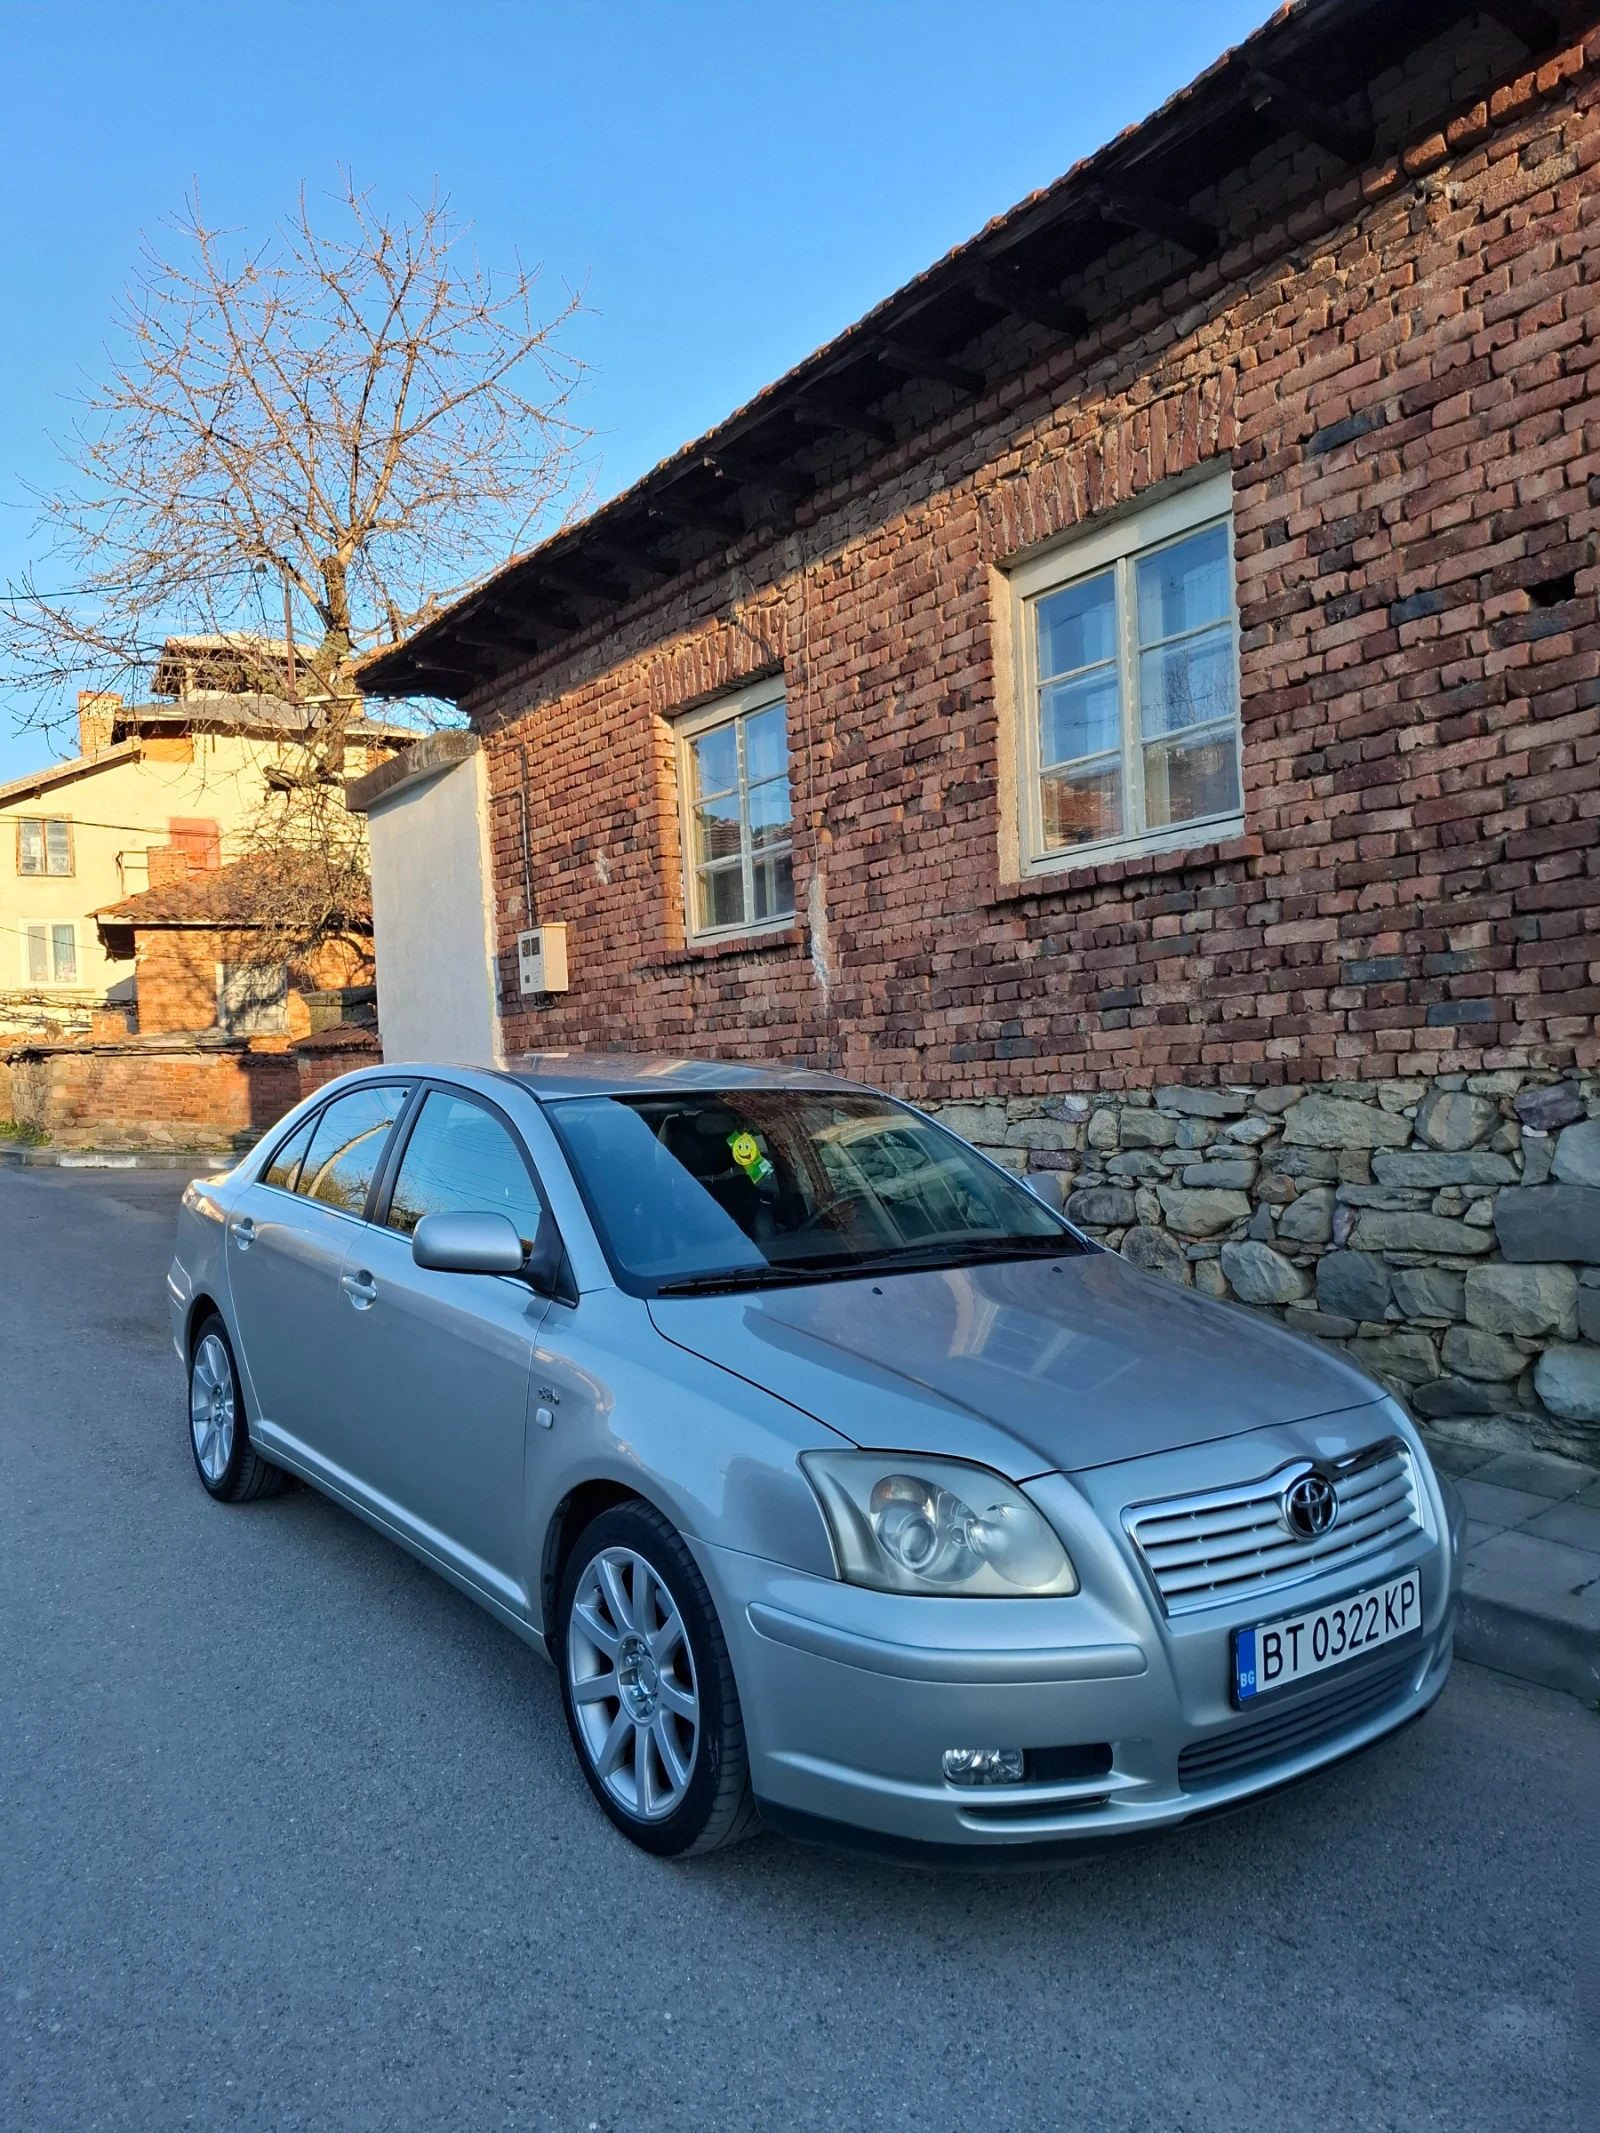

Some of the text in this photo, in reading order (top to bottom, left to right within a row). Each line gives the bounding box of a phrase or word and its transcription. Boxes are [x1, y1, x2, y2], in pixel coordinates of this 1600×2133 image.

[1263, 1580, 1415, 1681] BT 0322 KP
[1240, 1671, 1255, 1688] BG
